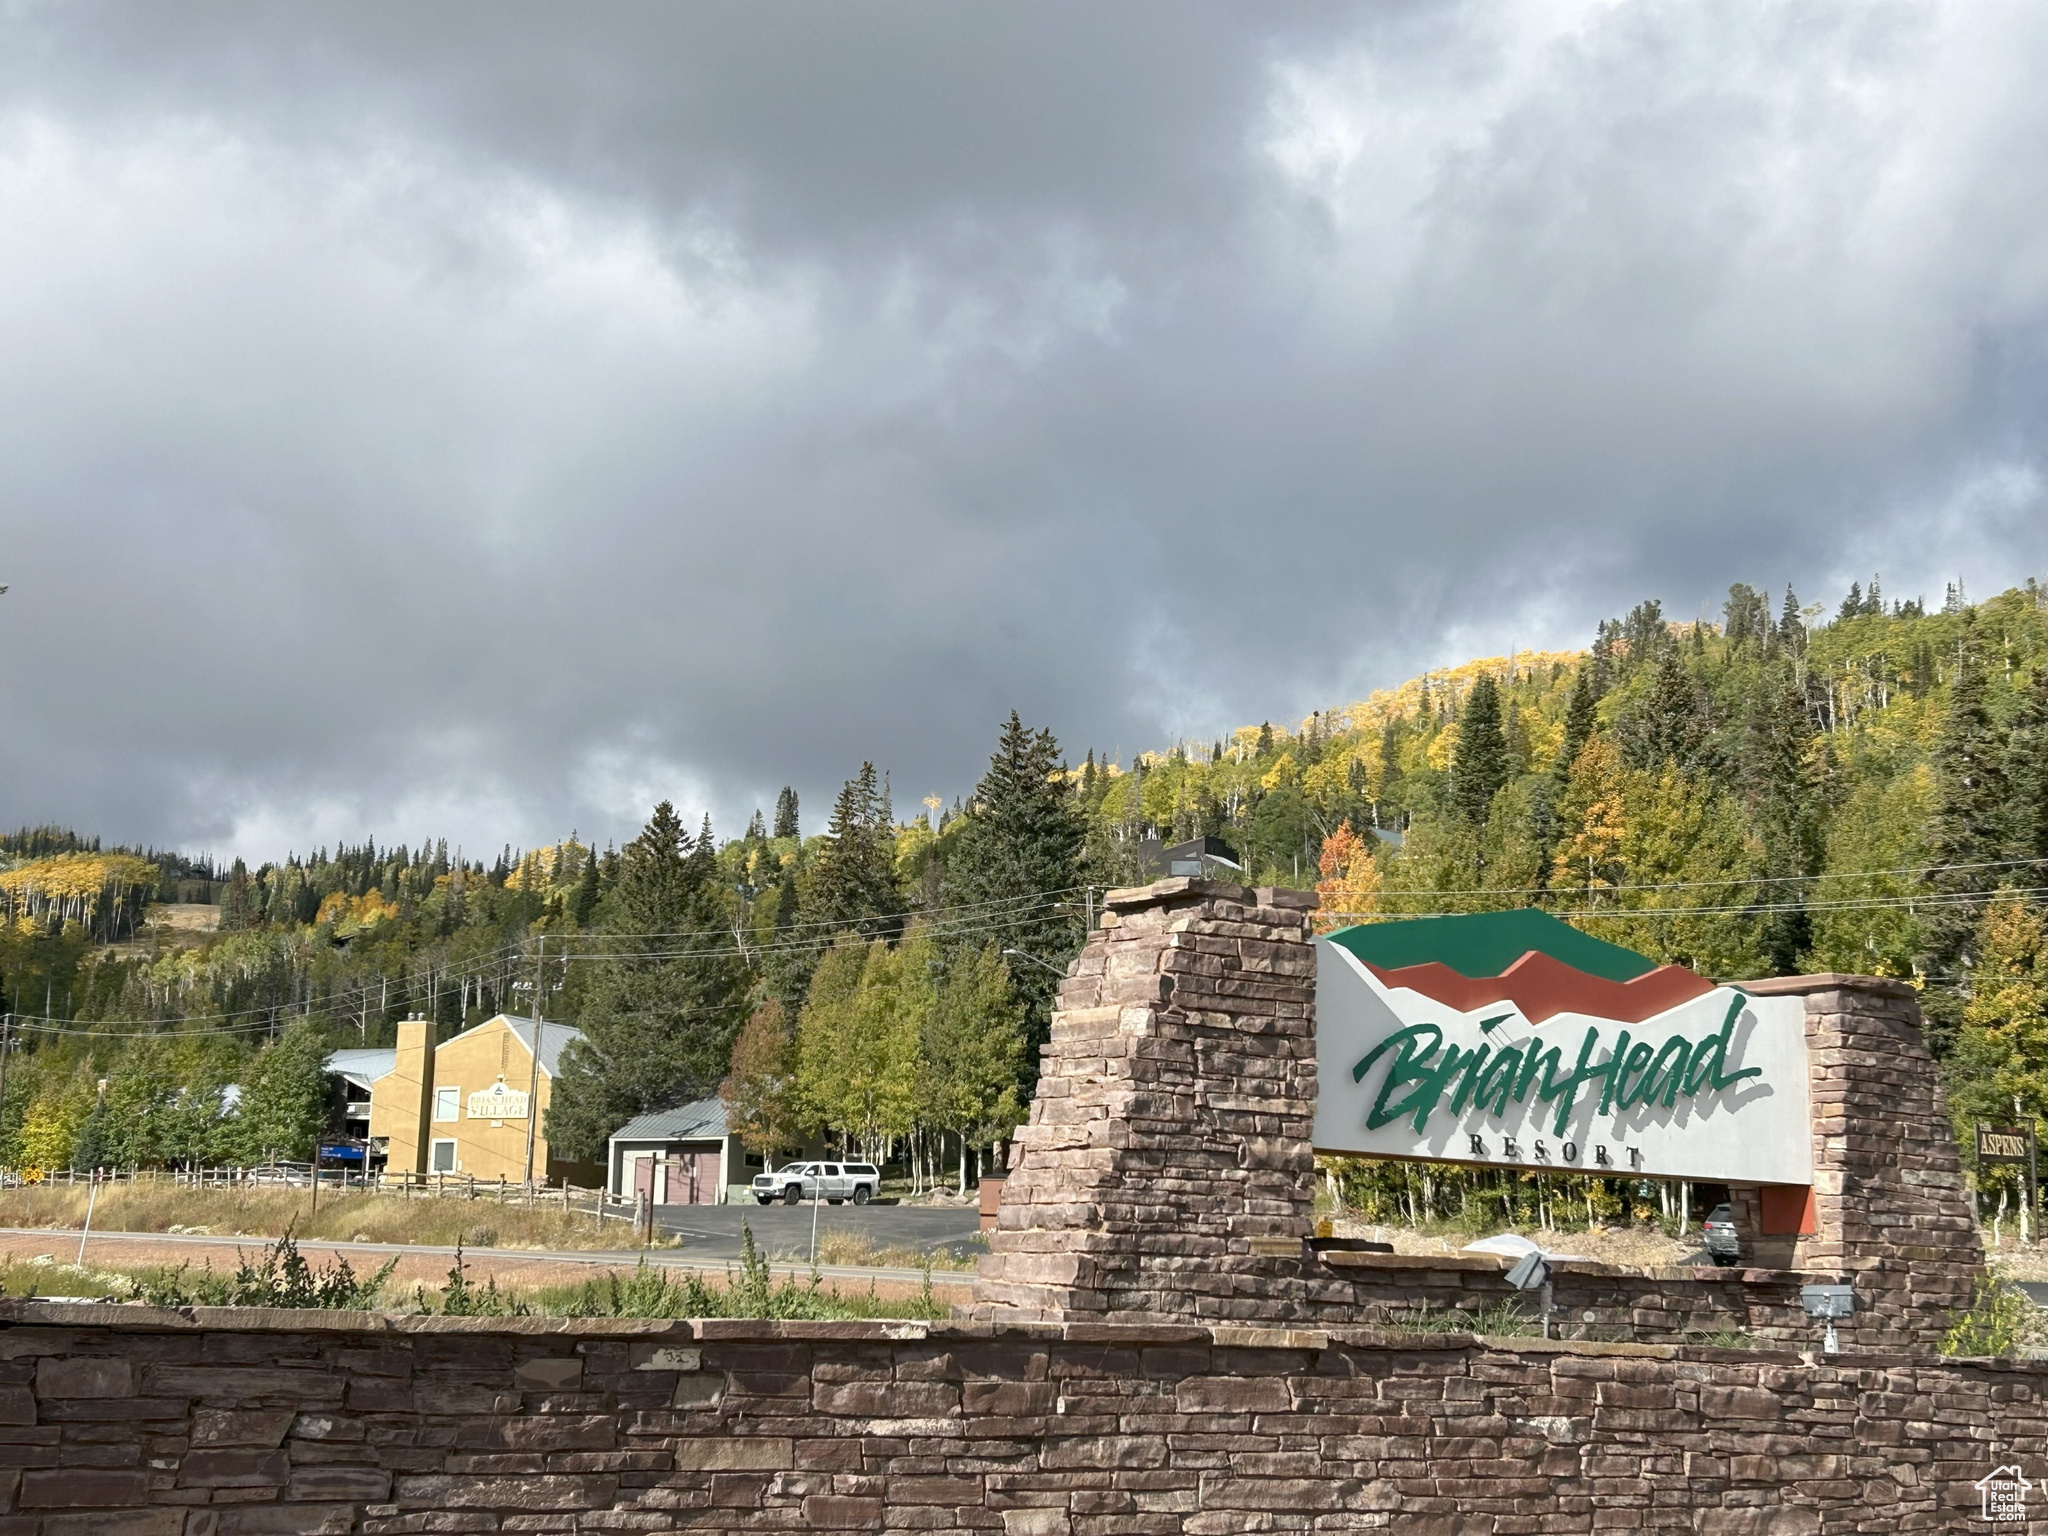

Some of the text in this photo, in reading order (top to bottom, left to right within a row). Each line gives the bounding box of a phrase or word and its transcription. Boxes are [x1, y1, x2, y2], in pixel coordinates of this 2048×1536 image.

[1352, 993, 1763, 1138] Brian Head
[470, 1096, 527, 1105] BRIAN HEAD
[470, 1105, 526, 1116] VILLAGE
[1468, 1133, 1639, 1167] RESORT
[1980, 1133, 2025, 1156] ASPENS
